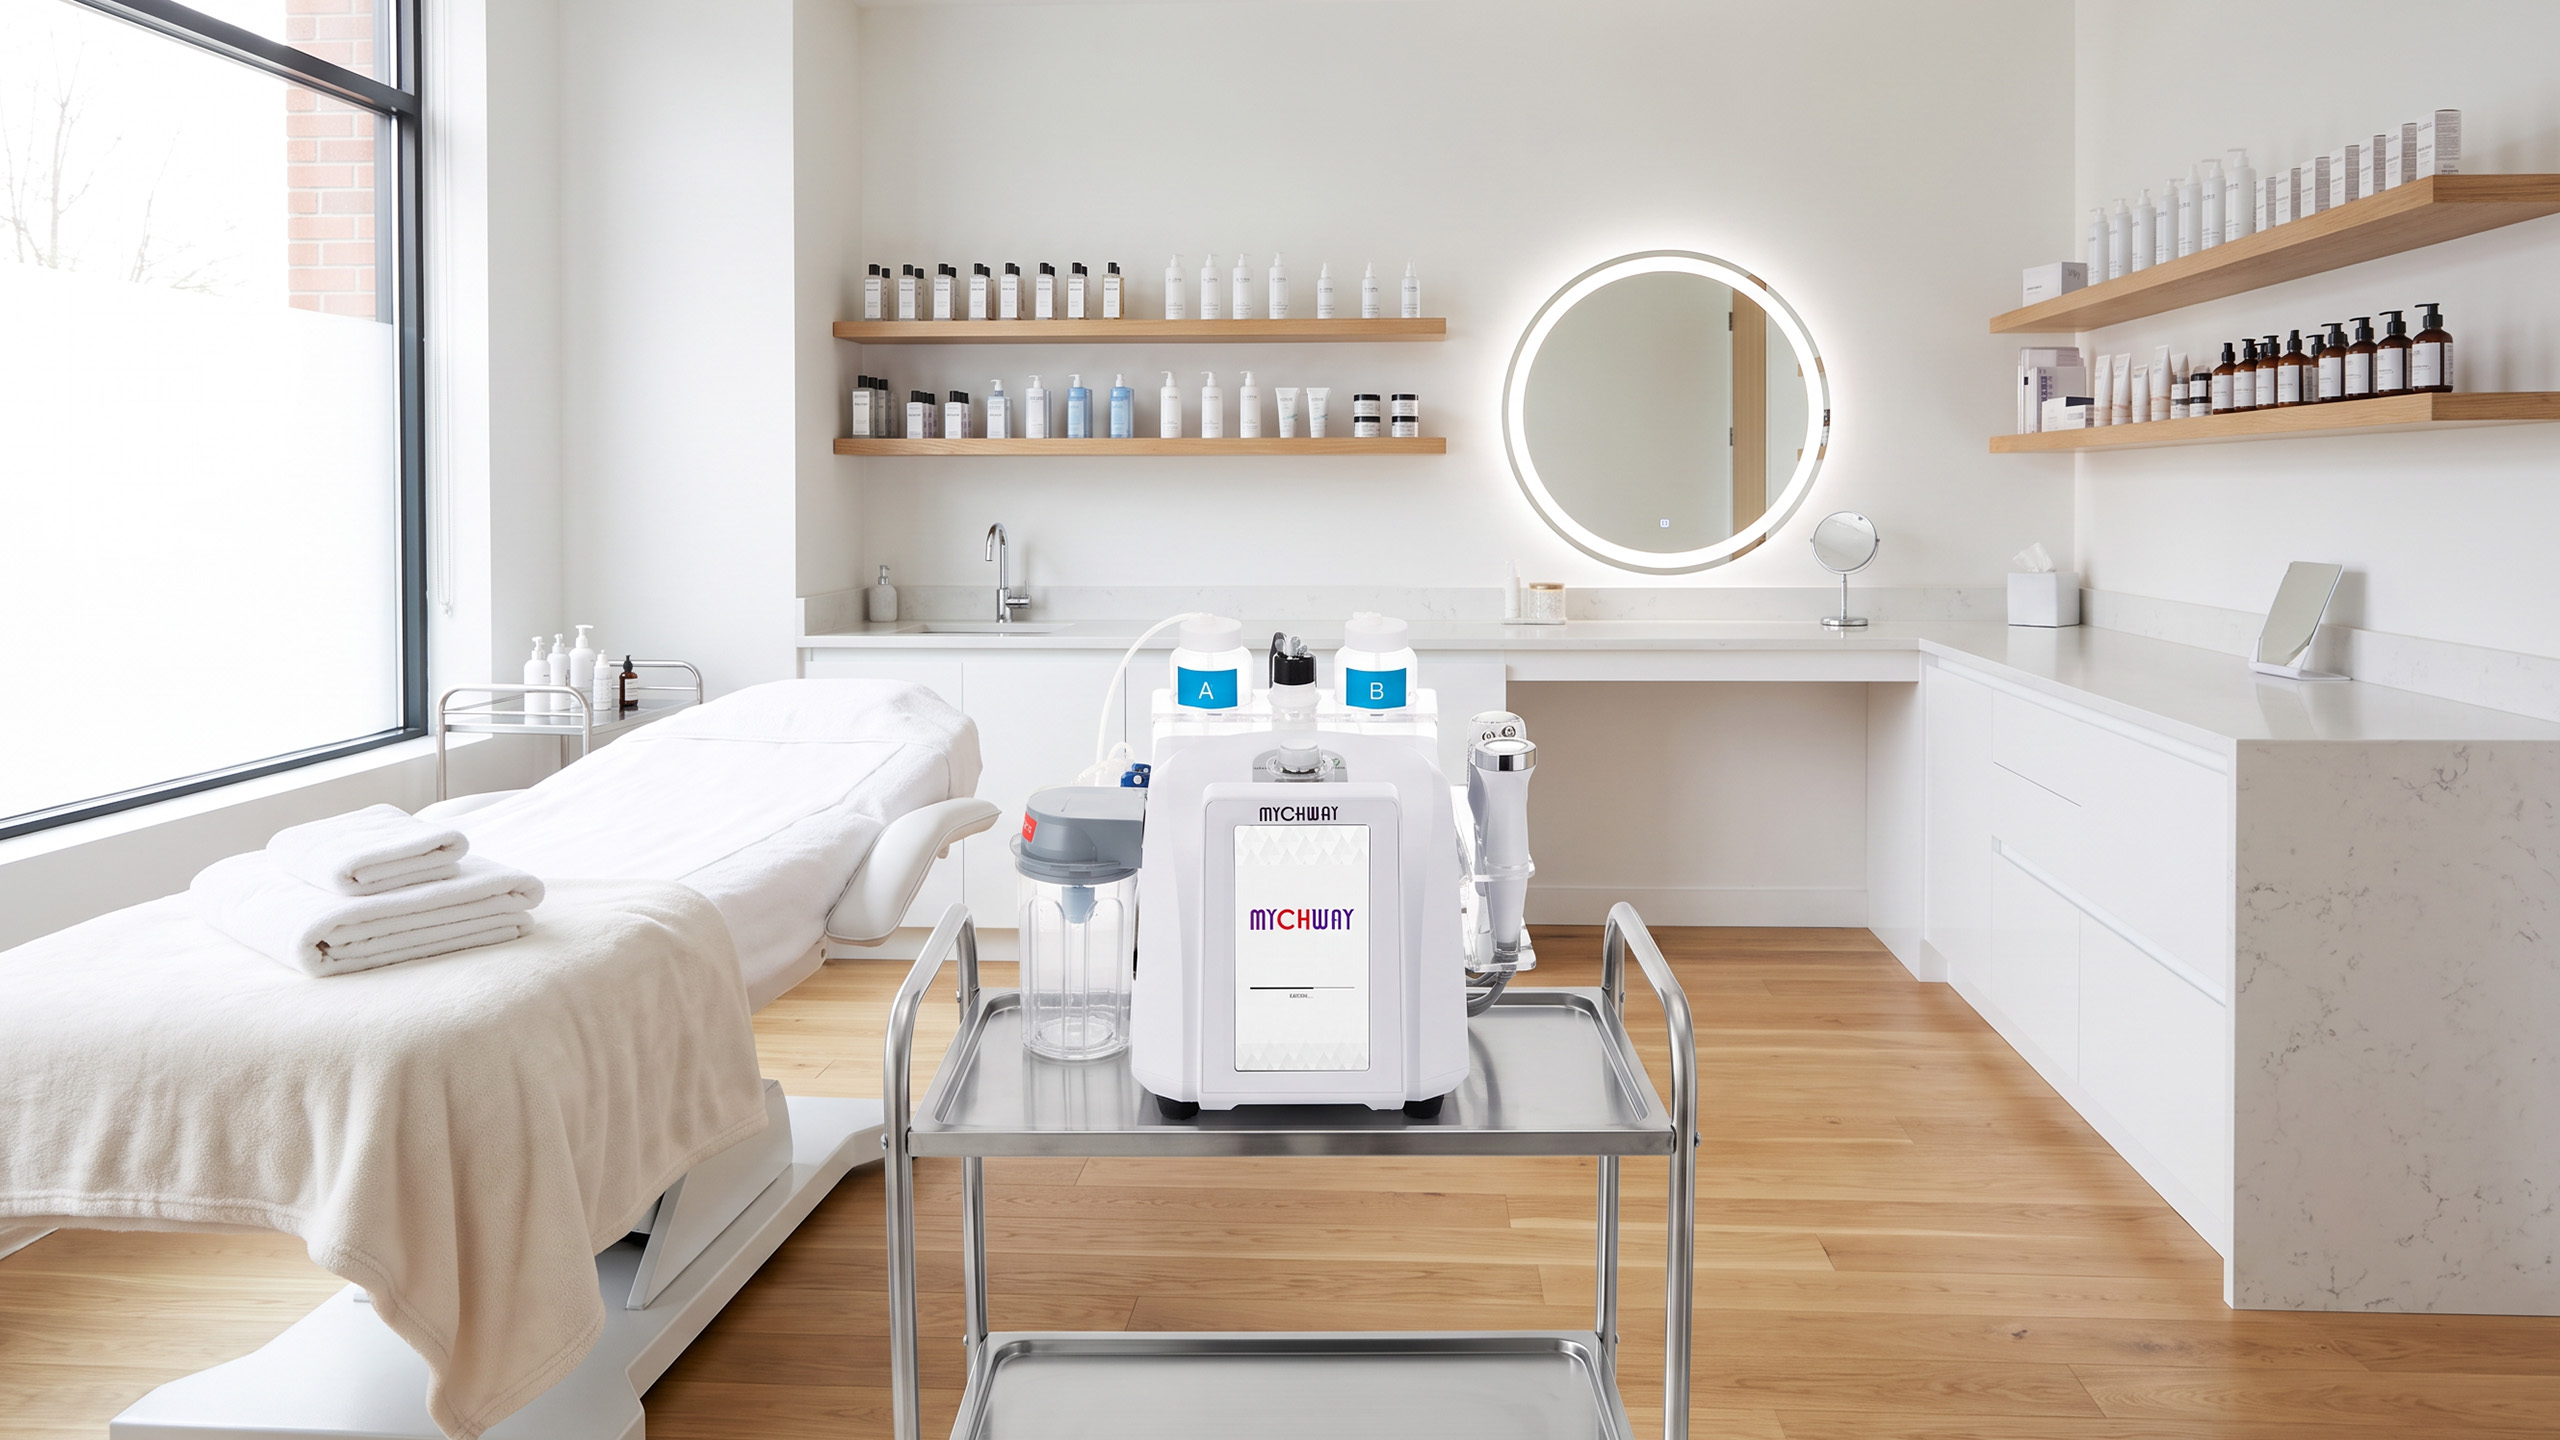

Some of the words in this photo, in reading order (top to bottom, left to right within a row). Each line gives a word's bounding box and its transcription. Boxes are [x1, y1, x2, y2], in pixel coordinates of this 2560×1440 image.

[1198, 681, 1214, 700] A
[1370, 682, 1384, 700] B
[1259, 805, 1339, 822] MYCHWAY
[1249, 908, 1355, 931] MYCHWAY
